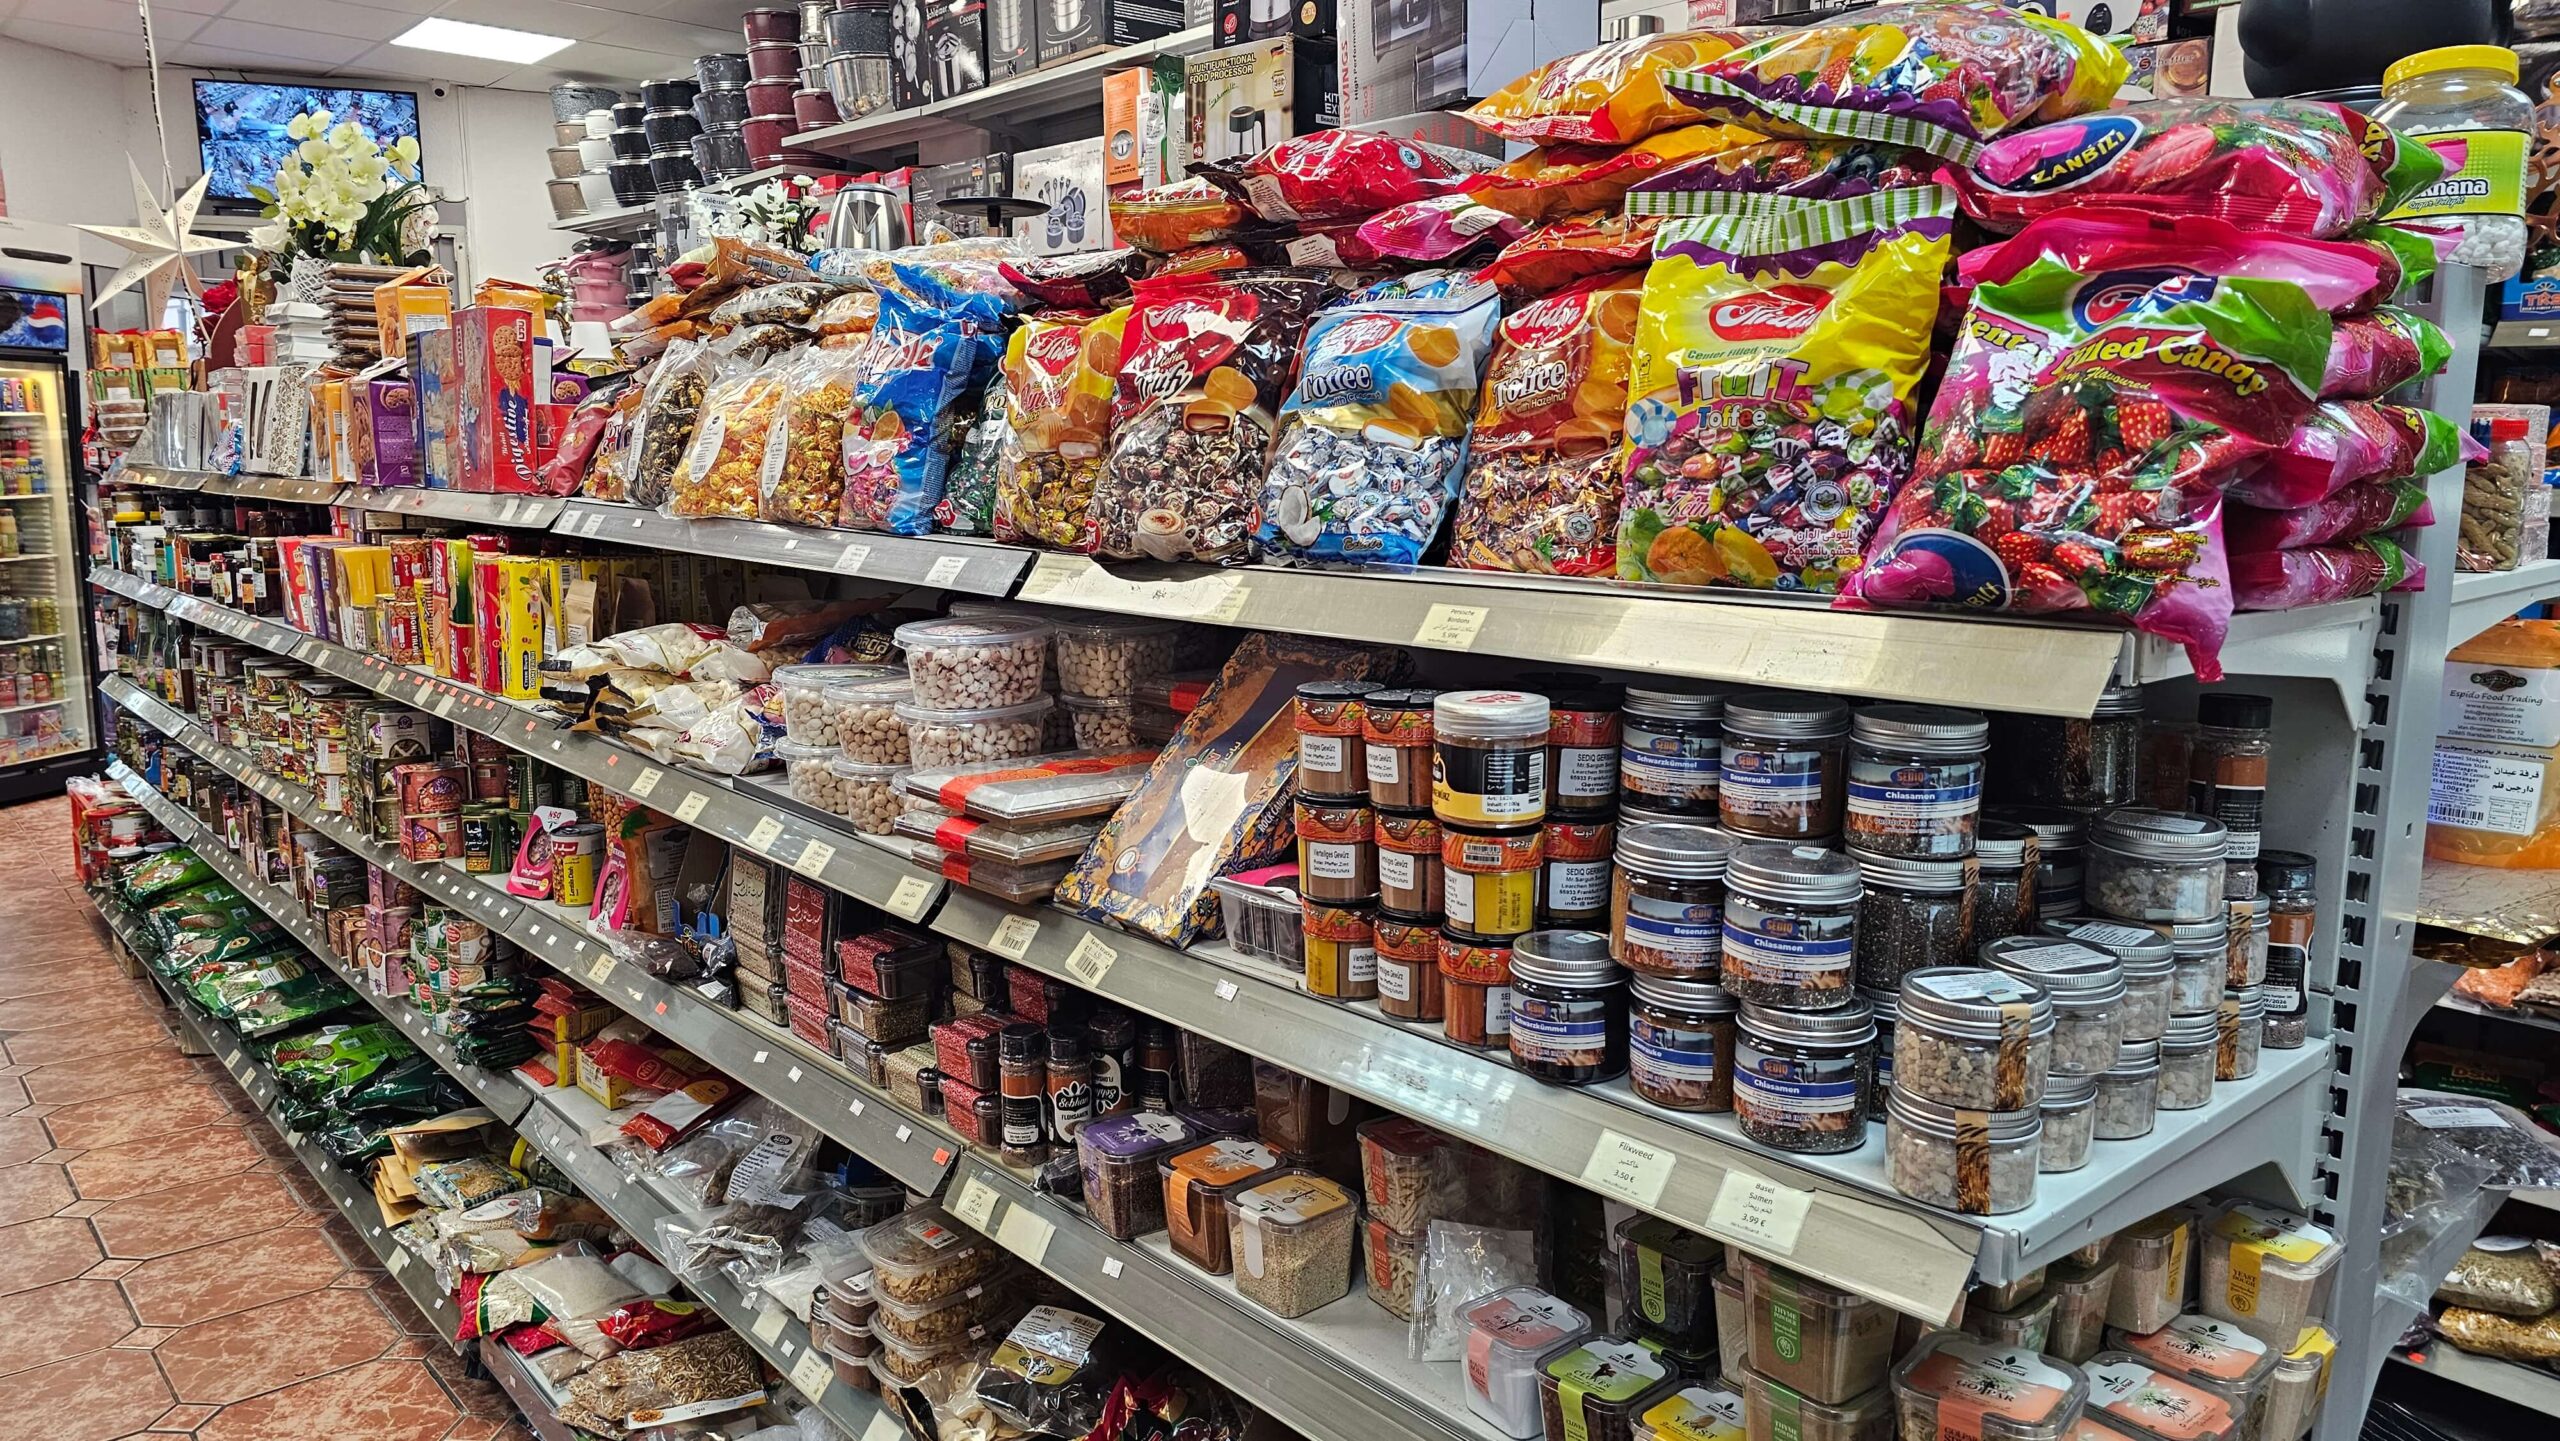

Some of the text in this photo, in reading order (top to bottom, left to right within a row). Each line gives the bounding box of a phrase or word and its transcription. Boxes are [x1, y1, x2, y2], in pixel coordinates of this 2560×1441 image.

[1189, 52, 1257, 75] MULTIFUNCTIONAL
[1189, 64, 1254, 85] FOOD PROCESSOR
[1340, 40, 1349, 125] IRVINGS
[2158, 336, 2270, 396] Candy
[1301, 365, 1371, 403] Toffee
[1493, 360, 1567, 411] Toffee
[1328, 395, 1346, 408] with
[1531, 391, 1568, 409] Hazelnut
[1698, 404, 1766, 428] Toffee
[504, 399, 534, 481] Digestive
[2449, 689, 2543, 706] Espido Food Trading
[2497, 734, 2535, 743] Deutschland
[1577, 753, 1596, 762] SEDIQ
[1637, 755, 1698, 769] Schwarzkümmel
[1730, 773, 1772, 785] Besenrauke
[1885, 791, 1936, 800] Chiasamen
[1258, 810, 1275, 832] ROCK
[1270, 791, 1290, 815] CANDY
[1566, 867, 1585, 876] SEDIQ
[1754, 938, 1804, 952] Chiasamen
[1514, 1015, 1568, 1033] Schwarzkümmel
[1754, 1078, 1800, 1094] Chiasamen
[1618, 1141, 1654, 1161] Flixweed
[1755, 1182, 1775, 1194] Basel
[1748, 1191, 1774, 1205] Samen
[2233, 1269, 2257, 1283] YEAST
[1773, 1305, 1797, 1320] THYME
[2166, 1340, 2218, 1362] GOLPAR
[1573, 1368, 1612, 1389] CLOVES
[1955, 1378, 2016, 1403] GOLPAR
[1674, 1414, 1719, 1439] YEAST
[1774, 1419, 1798, 1435] THYME
